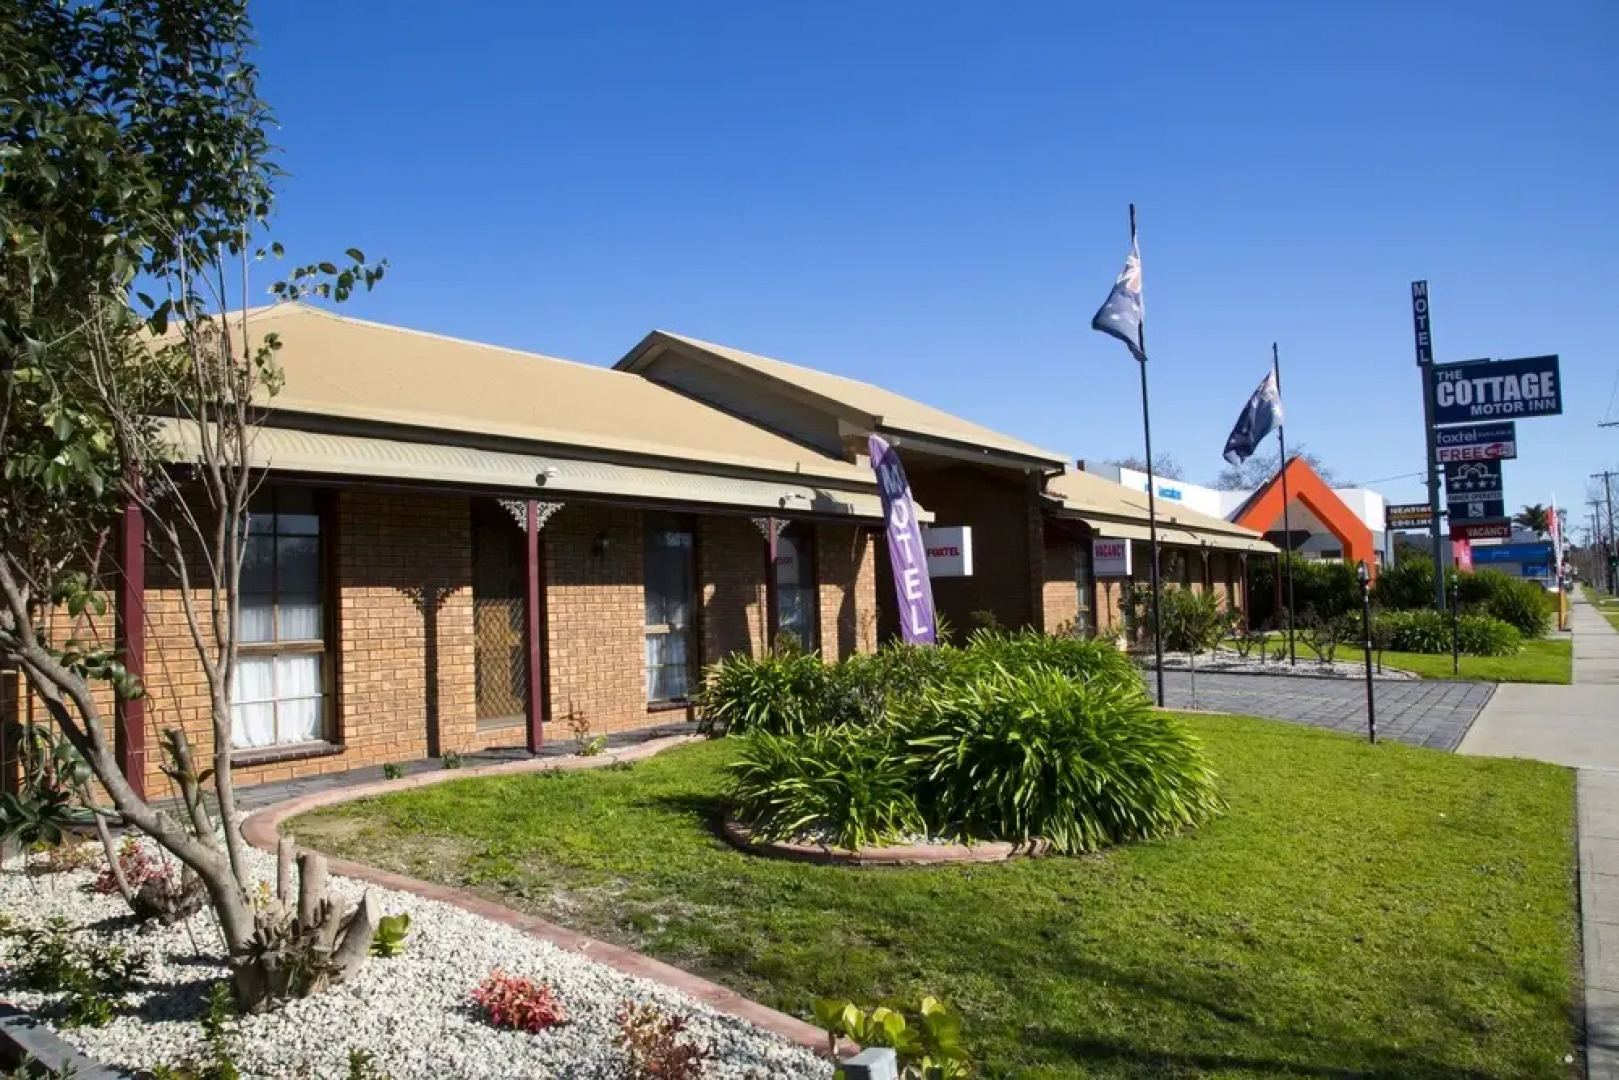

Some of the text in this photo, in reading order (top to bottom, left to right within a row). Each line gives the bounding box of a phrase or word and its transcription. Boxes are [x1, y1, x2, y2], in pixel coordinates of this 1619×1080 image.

[1413, 283, 1429, 362] MOTEL
[1436, 369, 1463, 381] THE
[1436, 371, 1555, 407] COTTAGE
[1471, 399, 1556, 416] MOTOR INN
[1437, 429, 1478, 444] foxtel
[1440, 446, 1483, 461] FREE
[1467, 525, 1508, 537] VACANCY
[880, 463, 929, 635] MOTEL
